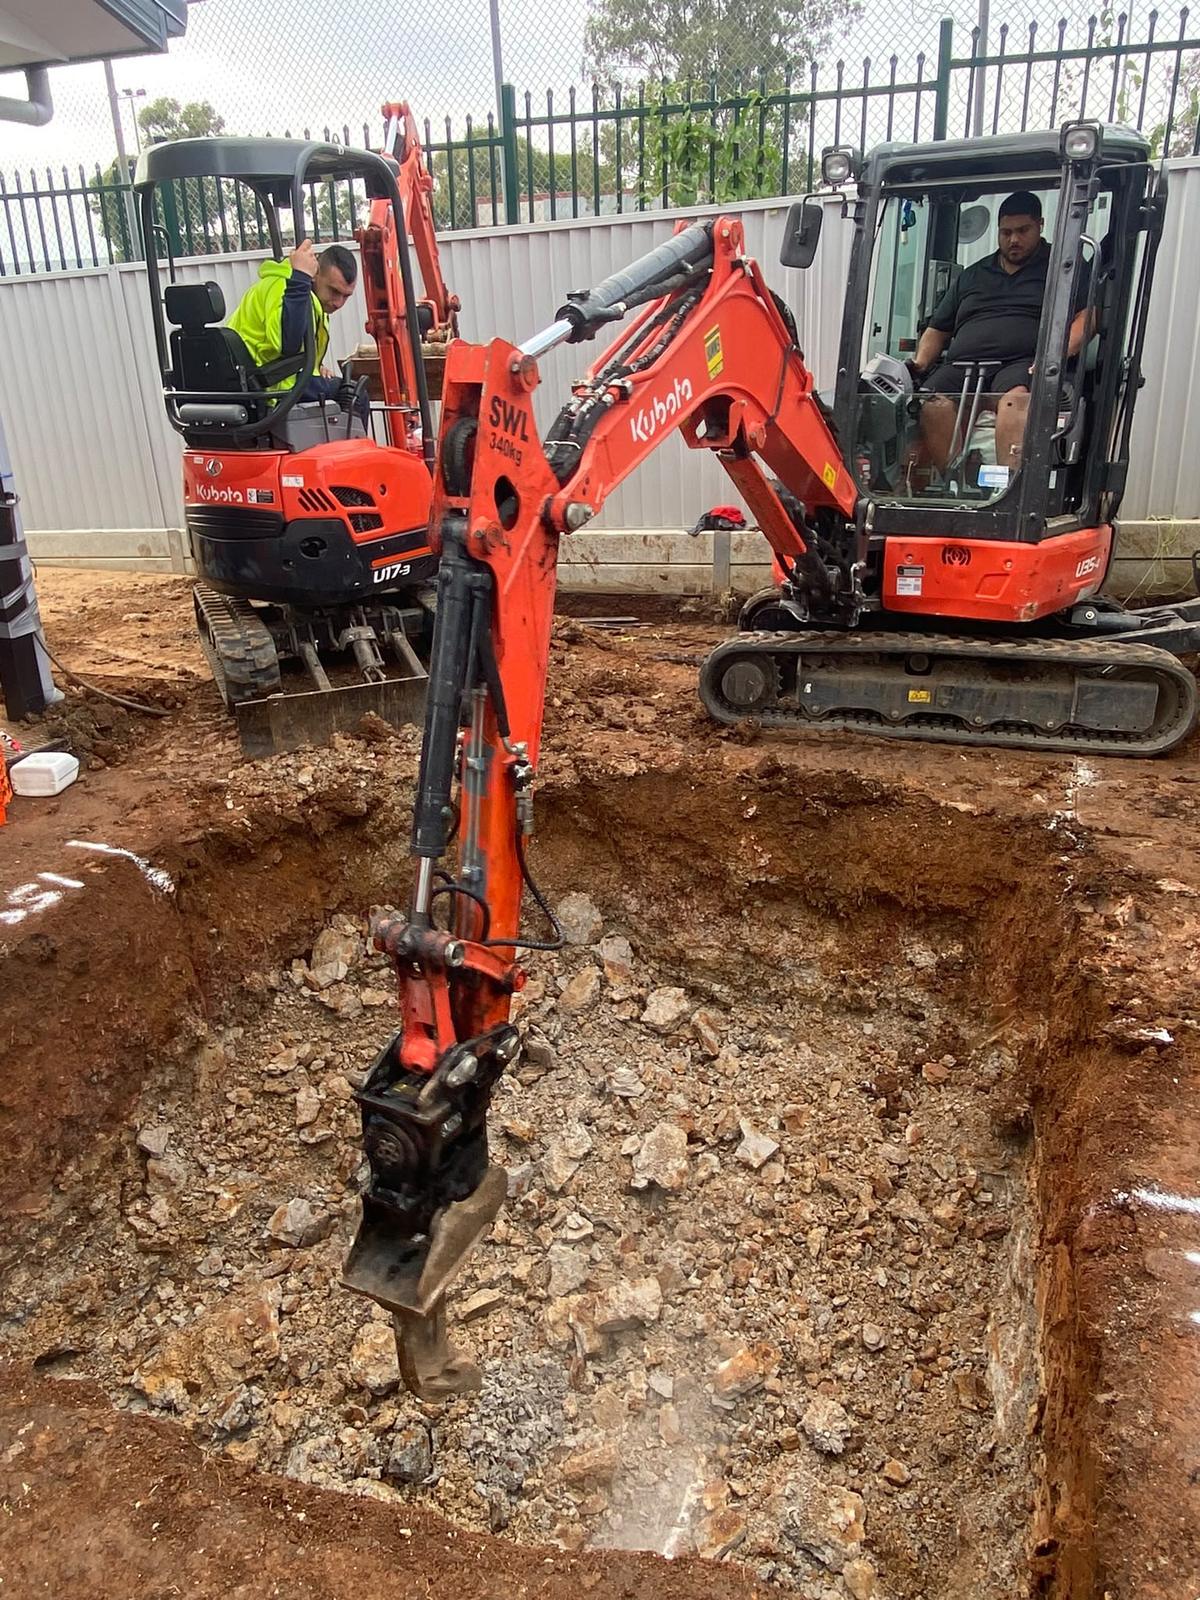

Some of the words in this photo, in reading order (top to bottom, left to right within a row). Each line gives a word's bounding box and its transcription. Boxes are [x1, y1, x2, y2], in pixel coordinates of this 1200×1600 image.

[489, 396, 529, 443] SWL
[631, 379, 692, 442] Kubota
[490, 432, 522, 466] 340kg
[197, 485, 243, 503] Kubota
[373, 563, 411, 584] U17-3
